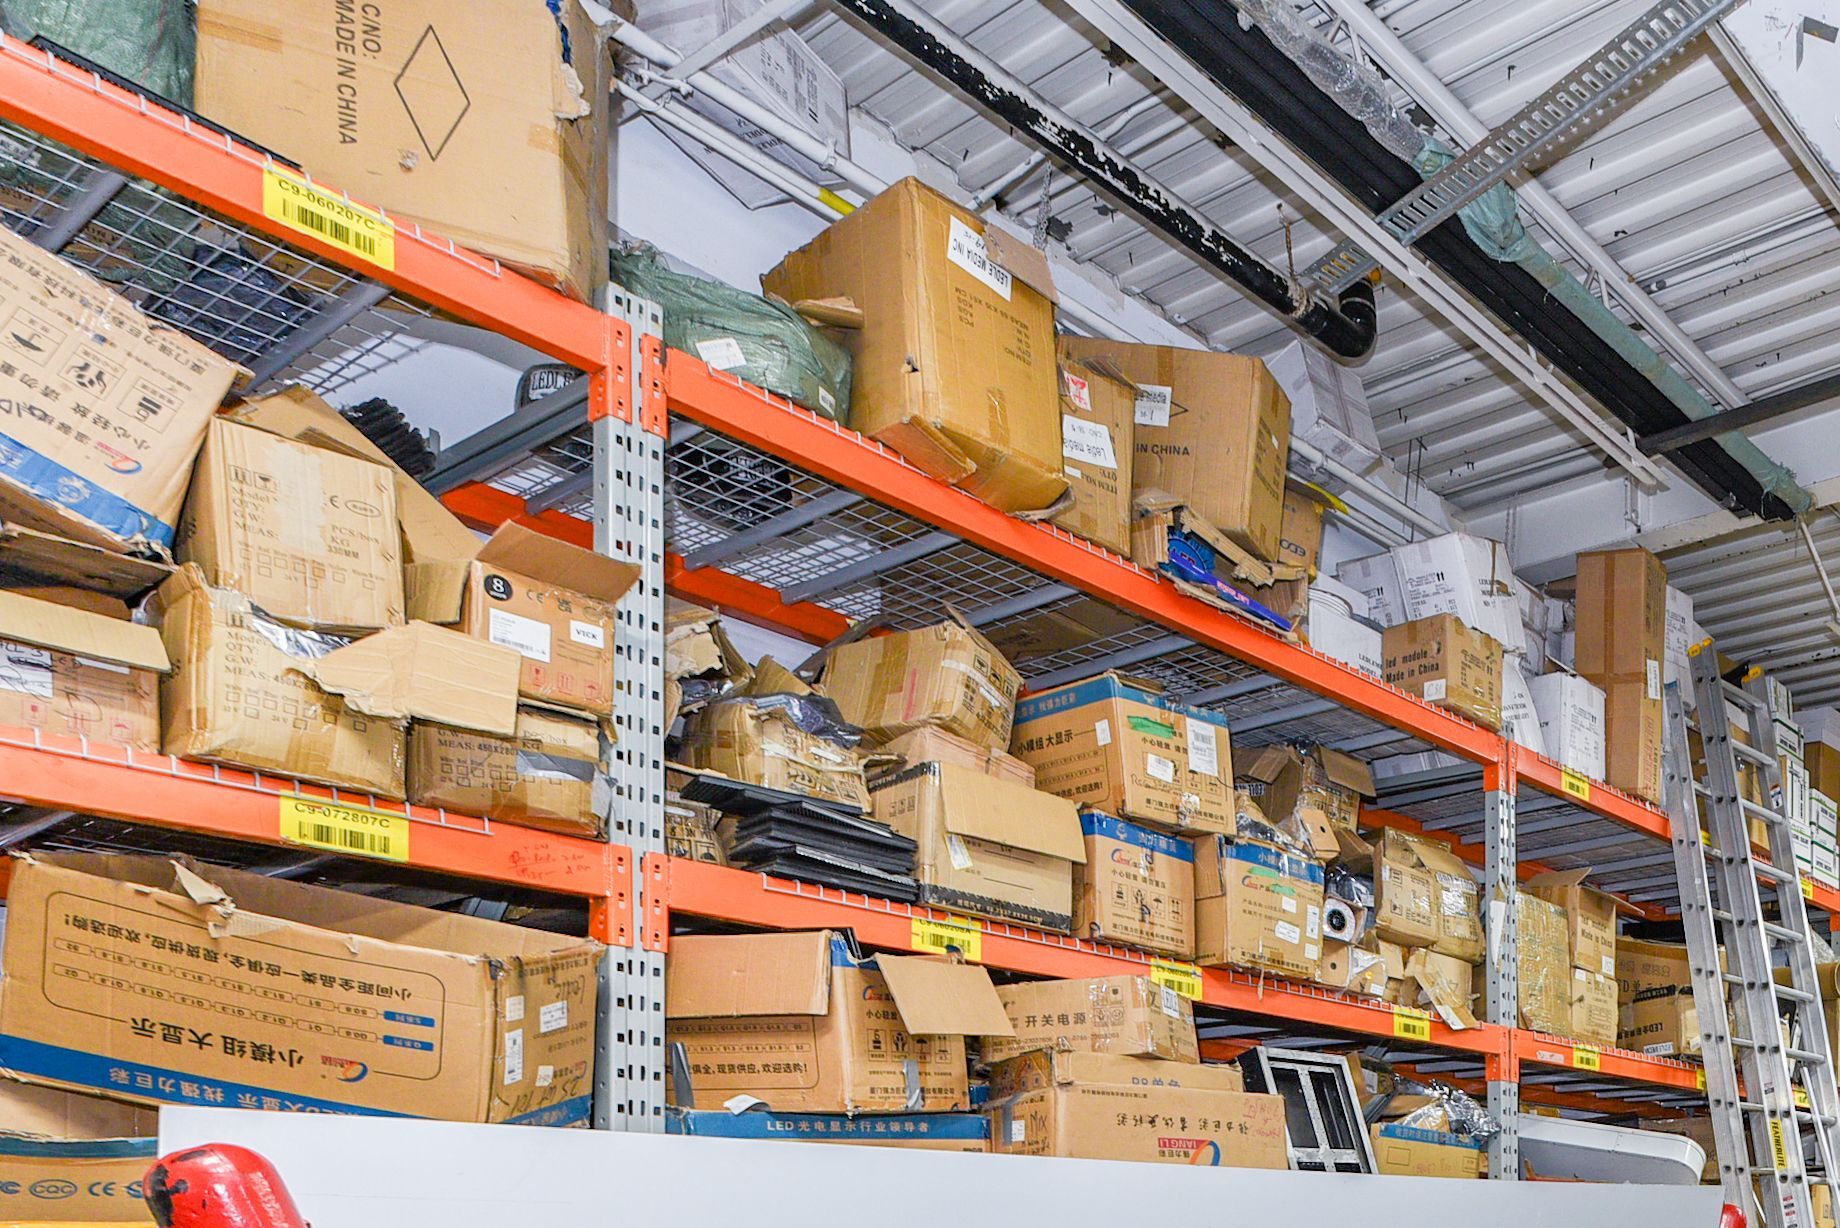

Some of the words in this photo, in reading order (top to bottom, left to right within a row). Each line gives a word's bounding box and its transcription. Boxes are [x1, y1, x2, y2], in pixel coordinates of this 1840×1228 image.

[335, 0, 355, 55] MADE
[361, 3, 381, 60] C/NO:
[336, 57, 356, 80] IN
[337, 83, 357, 144] CHINA
[278, 178, 376, 230] C9-060207C
[966, 249, 988, 272] MEDIA
[1136, 443, 1148, 454] IN
[1151, 444, 1190, 456] CHINA
[491, 576, 505, 593] 8
[1385, 657, 1397, 669] led
[1401, 648, 1428, 664] module
[224, 665, 269, 682] MEAS:
[1385, 670, 1405, 683] Made
[1407, 667, 1415, 678] in
[1418, 662, 1440, 676] China
[437, 737, 476, 752] MEAS:
[1046, 729, 1074, 747] 大显示
[294, 802, 392, 829] C9-072807C
[1581, 927, 1593, 941] Made
[1600, 935, 1614, 949] China
[1024, 1011, 1088, 1029] 开关电源
[130, 1015, 215, 1051] 大显示
[223, 1034, 304, 1068] 小模组
[108, 1065, 225, 1104] 找强力巨彩
[767, 1120, 794, 1132] LED
[797, 1119, 930, 1133] 光电显示行业领导者
[1771, 1121, 1786, 1168] FEATHERLITE
